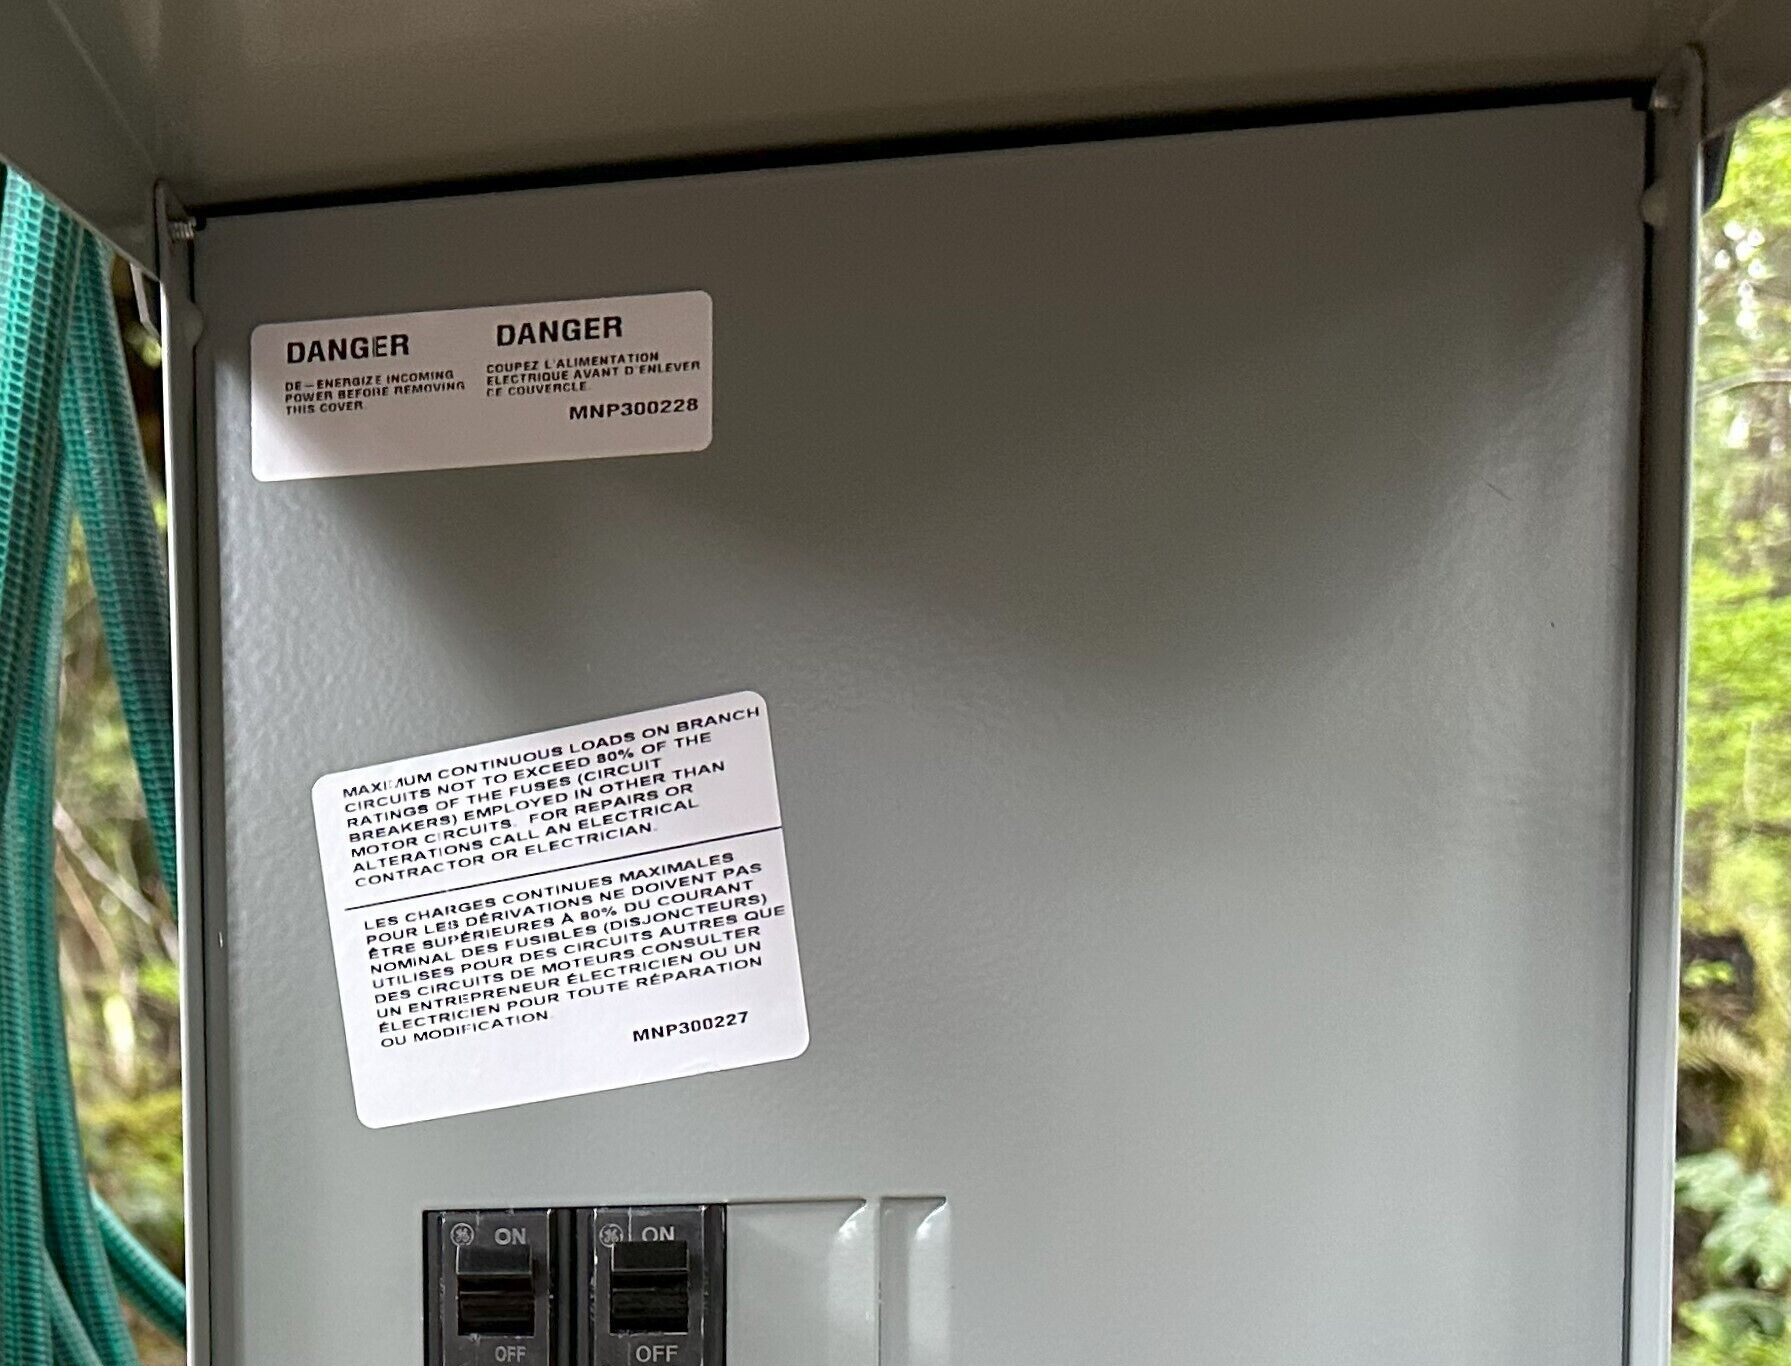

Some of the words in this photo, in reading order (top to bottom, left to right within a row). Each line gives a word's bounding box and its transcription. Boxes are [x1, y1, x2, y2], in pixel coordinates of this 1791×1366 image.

[286, 333, 409, 364] DANGER
[496, 315, 622, 347] DANGER
[386, 369, 454, 384] INCOMING
[486, 360, 539, 374] COUPEZ
[486, 369, 568, 386] ELECTRIQUE
[572, 366, 619, 380] AVANT
[284, 390, 332, 403] POWER
[337, 384, 389, 399] BEFORE
[393, 380, 465, 395] REMOVING
[285, 404, 315, 415] THIS
[319, 399, 363, 413] COVER
[568, 397, 698, 420] MNP300228
[437, 745, 565, 779] CONTINUOUS
[569, 731, 636, 753] LOADS
[639, 723, 670, 740] ON
[675, 705, 760, 734] BRANCH
[344, 788, 431, 812] CIRCUITS
[437, 778, 476, 795] NOT
[481, 773, 507, 786] TO
[512, 756, 590, 780] EXCEED
[596, 746, 634, 764] 80%
[640, 739, 666, 754] OF
[669, 731, 711, 748] THE
[346, 803, 428, 828] RATINGS
[435, 797, 459, 811] OF
[465, 788, 502, 804] THE
[508, 775, 571, 797] FUSES
[577, 756, 662, 785] (CIRCUIT
[348, 813, 457, 842] BREAKERS)
[463, 792, 568, 821] EMPLOYED
[574, 786, 592, 800] IN
[598, 772, 666, 794] OTHER
[670, 760, 724, 780] THAN
[350, 836, 418, 858] MOTOR
[528, 807, 568, 824] FOR
[574, 789, 659, 815] REPAIRS
[664, 782, 693, 797] OR
[352, 839, 483, 873] ALTERATIONS
[489, 829, 540, 846] CALL
[544, 821, 571, 836] AN
[577, 796, 699, 830] ELECTRICAL
[354, 854, 485, 887] CONTRACTOR
[490, 847, 518, 861] OR
[404, 897, 496, 922] CHARGES
[502, 875, 612, 904] CONTINUES
[618, 851, 734, 883] MAXIMALES
[365, 926, 418, 945] POUR
[465, 894, 593, 927] DÉRIVATIONS
[599, 887, 625, 902] NE
[631, 870, 717, 896] DOIVENT
[722, 862, 762, 879] PAS
[421, 916, 554, 949] SUPÉRIEURES
[579, 905, 617, 920] 80%
[623, 898, 650, 913] DU
[656, 878, 753, 906] COURANT
[370, 950, 455, 974] NOMINAL
[460, 942, 498, 958] DES
[504, 924, 597, 950] FUSIBLES
[603, 892, 767, 934] (DISJONCTEURS)
[372, 965, 454, 989] UTILISES
[460, 954, 513, 973] POUR
[519, 947, 557, 963] DES
[562, 929, 653, 954] CIRCUITS
[658, 913, 738, 938] AUTRES
[743, 904, 785, 921] QUE
[374, 988, 411, 1004] DES
[416, 972, 504, 996] CIRCUITS
[510, 966, 535, 980] DE
[541, 948, 635, 974] MOTEURS
[640, 925, 760, 955] CONSULTER
[376, 1005, 402, 1018] UN
[408, 977, 560, 1013] ENTREPRENEUR
[566, 952, 692, 984] ÉLECTRICIEN
[699, 946, 727, 960] OU
[733, 940, 761, 954] UN
[378, 1002, 500, 1033] ÉLECTRICIEN
[506, 992, 559, 1011] POUR
[565, 979, 629, 1000] TOUTE
[635, 955, 762, 987] RÉPARATION
[380, 1034, 406, 1047] OU
[632, 1010, 748, 1042] MNP300227
[495, 1228, 526, 1245] ON
[642, 1226, 675, 1242] ON
[495, 1346, 526, 1363] OFF
[636, 1345, 678, 1363] OFF
